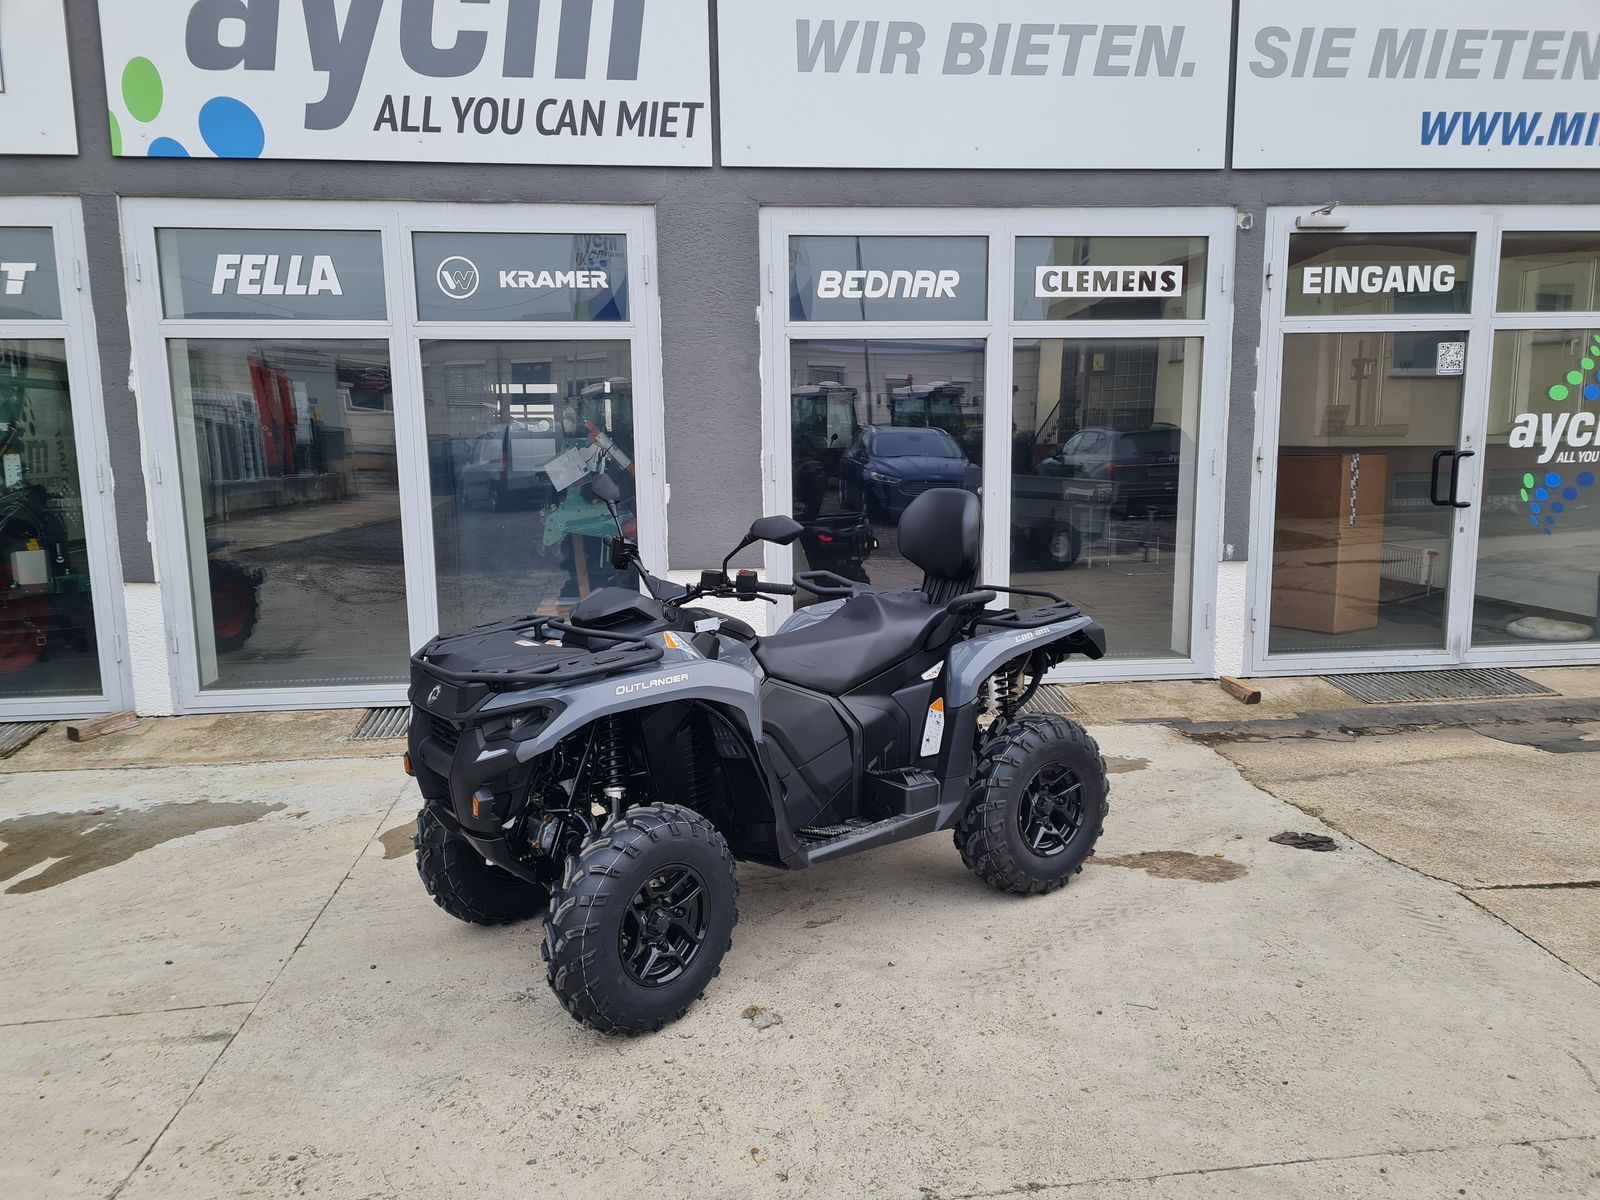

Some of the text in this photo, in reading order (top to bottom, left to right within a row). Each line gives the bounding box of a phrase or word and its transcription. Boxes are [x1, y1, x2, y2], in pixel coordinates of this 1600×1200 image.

[796, 19, 1196, 77] WIR BIETEN.
[1249, 26, 1600, 80] SIE MIETEN
[373, 95, 704, 138] ALL YOU CAN MIET
[1421, 111, 1600, 146] WWW.MI
[211, 254, 344, 295] FELLA
[499, 270, 609, 289] KRAMER
[817, 270, 960, 298] BEDNAR
[1041, 270, 1176, 292] CLEMENS
[1302, 264, 1455, 294] EINGANG
[1509, 412, 1600, 464] ayc
[1556, 451, 1599, 463] ALL YOU
[1015, 625, 1050, 643] can-am
[615, 673, 689, 696] OUTLANDER
